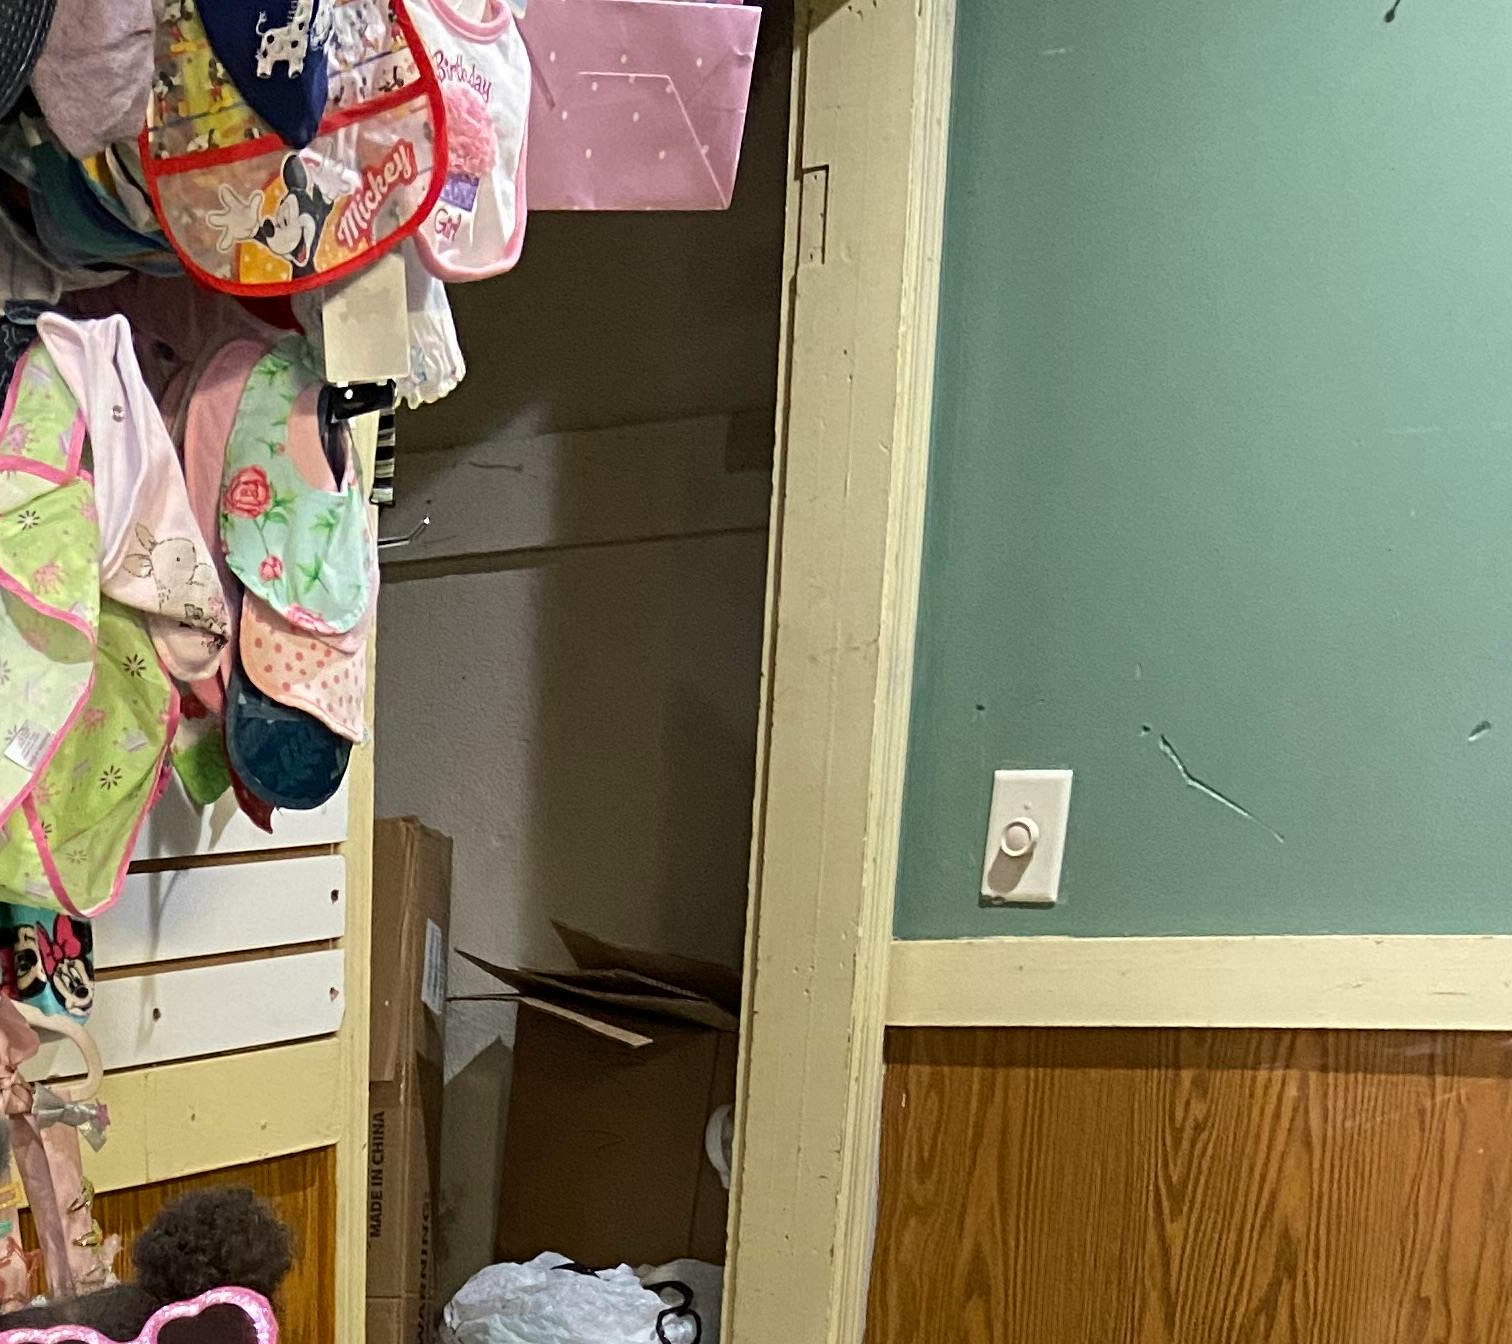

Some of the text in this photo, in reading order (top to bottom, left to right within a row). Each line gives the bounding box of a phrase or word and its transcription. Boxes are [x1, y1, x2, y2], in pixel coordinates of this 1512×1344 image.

[432, 51, 492, 103] Birthday
[338, 144, 413, 249] Mickey
[369, 1110, 385, 1238] MADE IN CHINA
